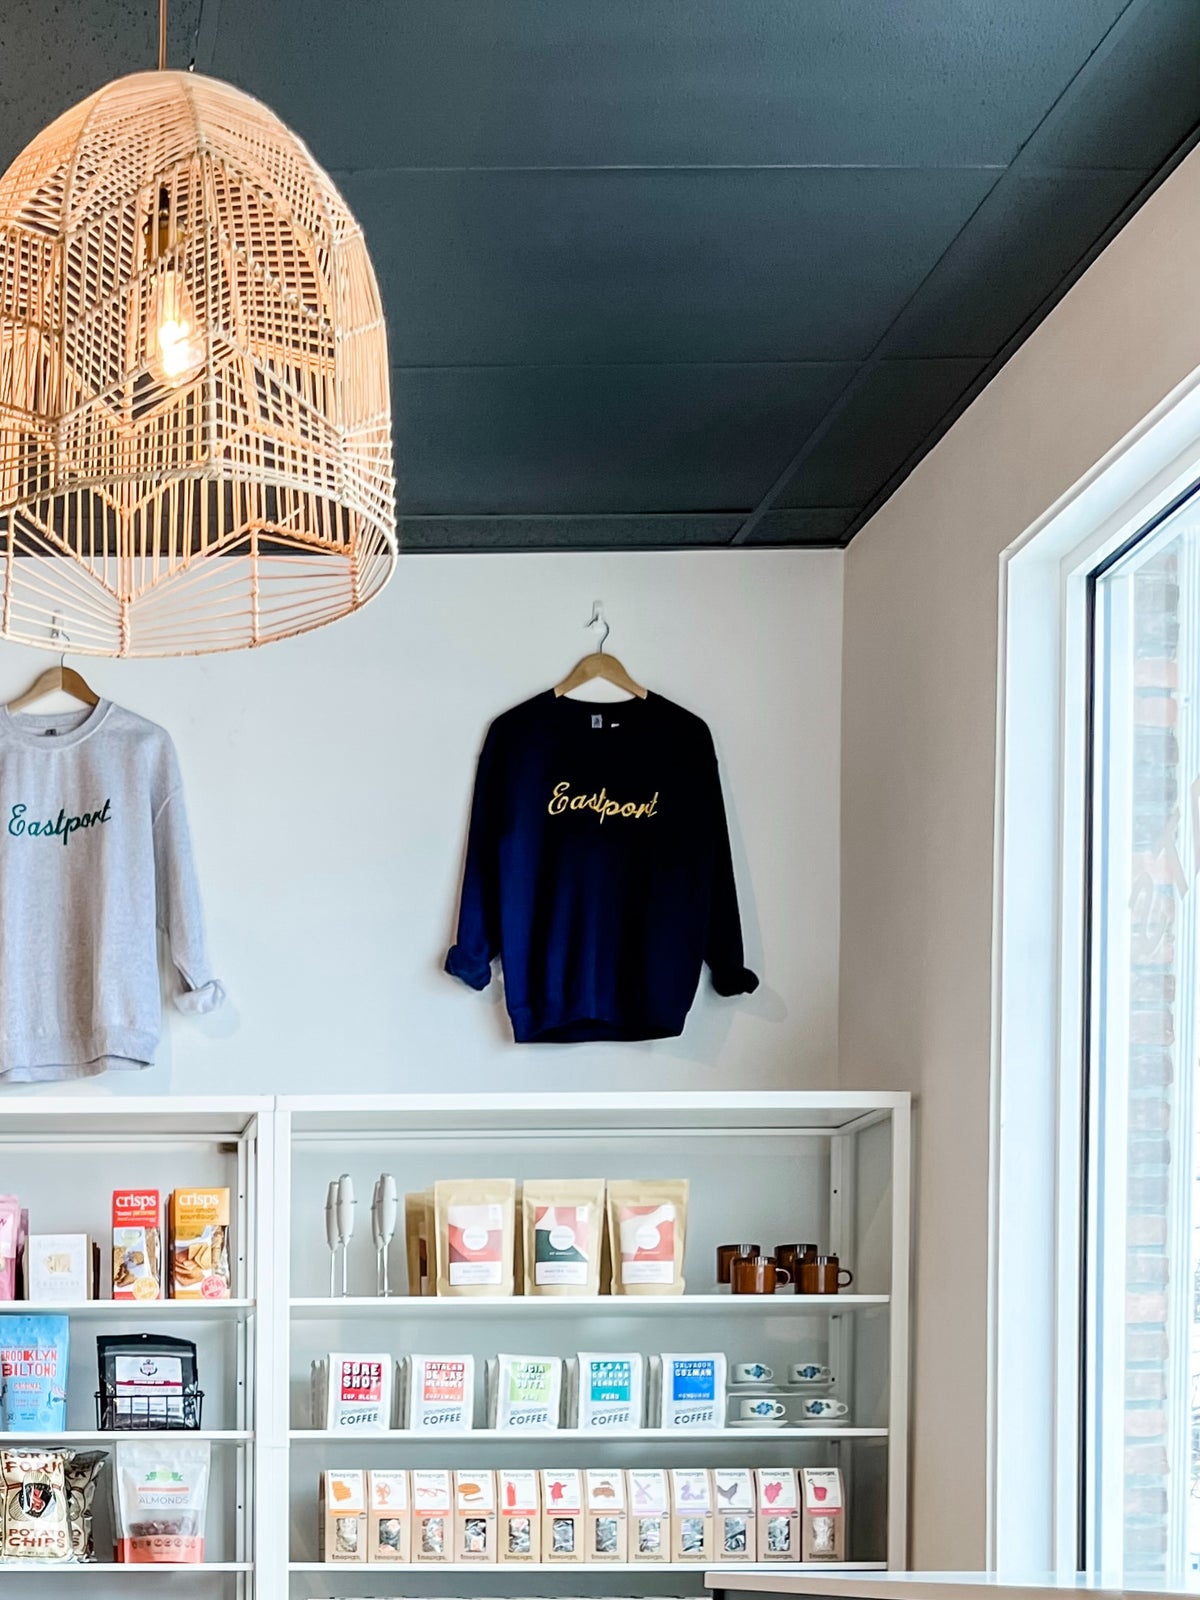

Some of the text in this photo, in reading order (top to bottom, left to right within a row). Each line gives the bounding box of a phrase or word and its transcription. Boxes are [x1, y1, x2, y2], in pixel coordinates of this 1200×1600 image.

[548, 782, 659, 824] Eastport
[8, 799, 111, 845] Eastport
[116, 1194, 156, 1210] crisps
[179, 1193, 219, 1208] crisps
[1, 1350, 57, 1361] BROOKLYN
[2, 1363, 57, 1377] BILTONG
[343, 1363, 379, 1375] SURE
[426, 1363, 463, 1371] CATALAN
[343, 1375, 379, 1388] SHOT
[426, 1371, 464, 1381] DE LAS
[340, 1413, 378, 1425] COFFEE
[423, 1413, 461, 1425] COFFEE
[509, 1413, 548, 1425] COFFEE
[591, 1413, 629, 1425] COFFEE
[674, 1411, 713, 1424] COFFEE
[139, 1496, 190, 1504] ALMONDS
[8, 1537, 66, 1548] CHIPS
